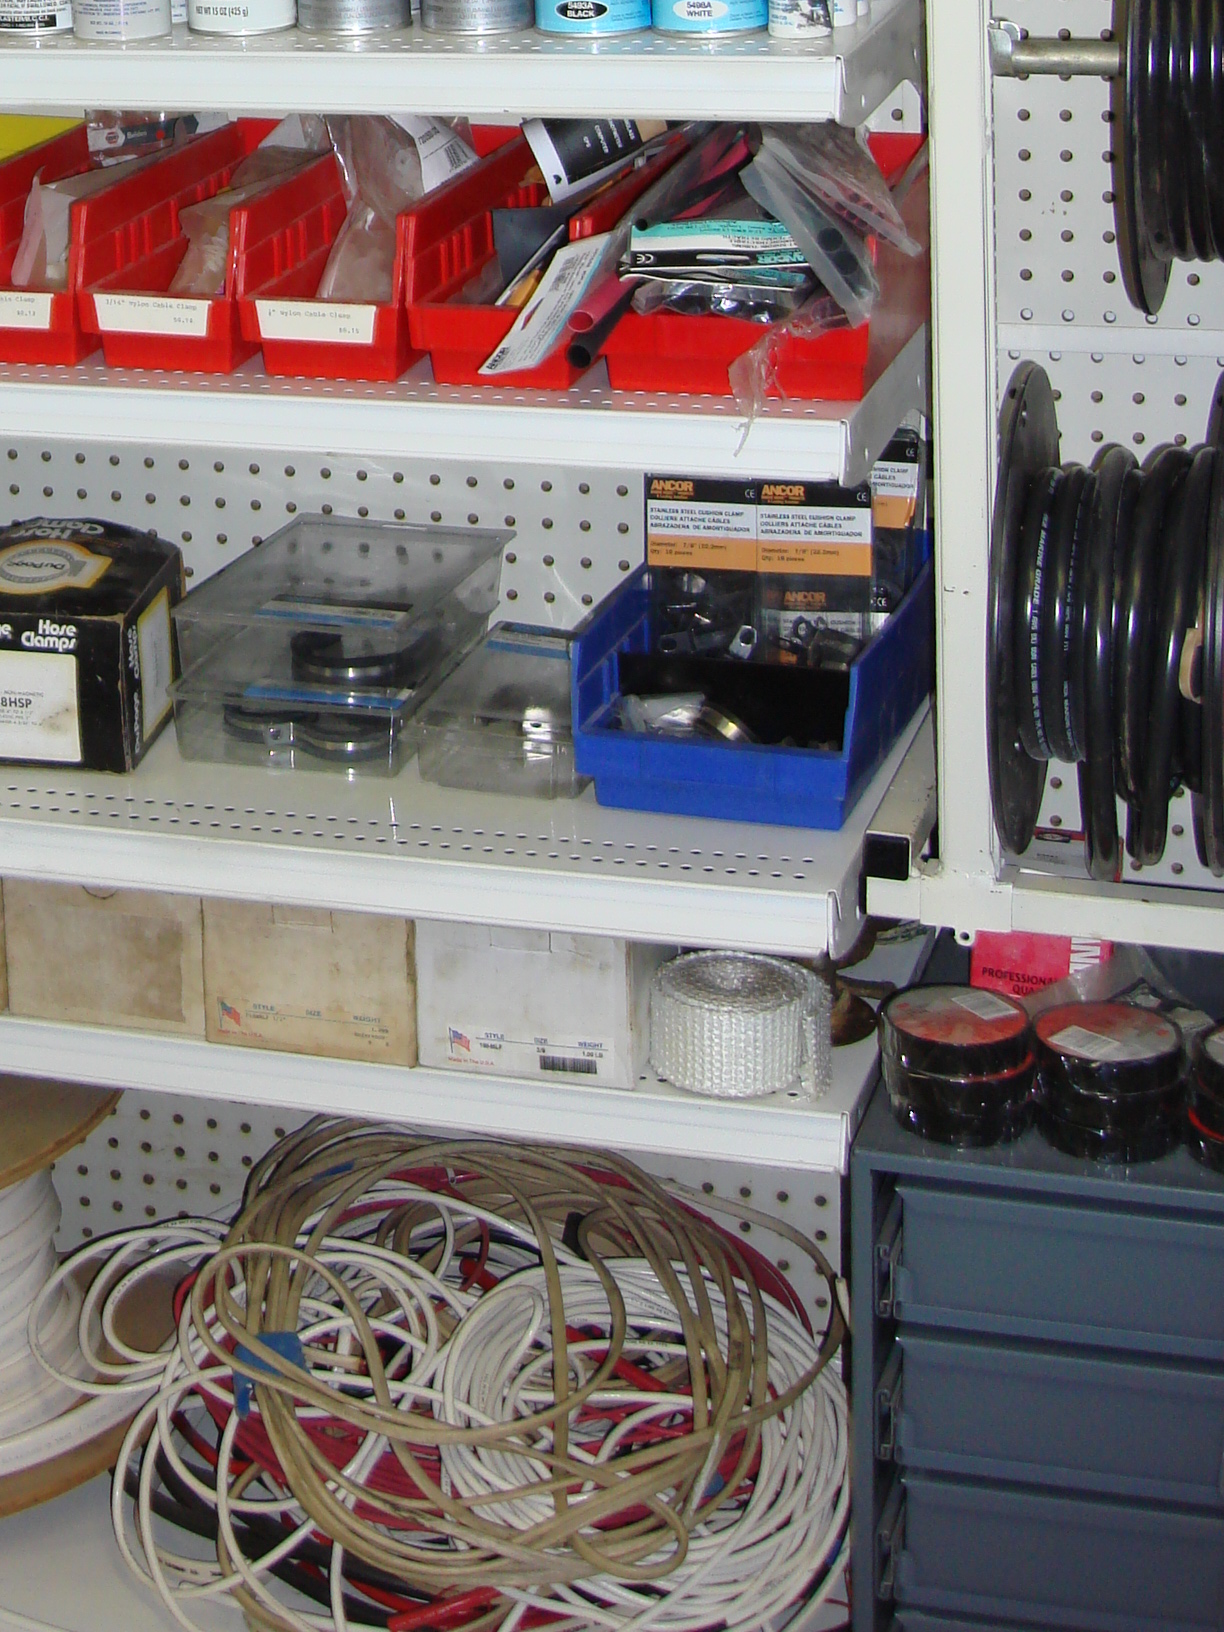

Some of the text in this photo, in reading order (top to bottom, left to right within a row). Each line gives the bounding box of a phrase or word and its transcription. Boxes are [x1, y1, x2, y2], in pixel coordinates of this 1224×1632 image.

[686, 9, 713, 18] WHITE
[650, 480, 694, 492] ANCOR
[761, 485, 805, 497] ANCOR
[38, 619, 76, 636] Hose
[21, 631, 76, 652] Clamps
